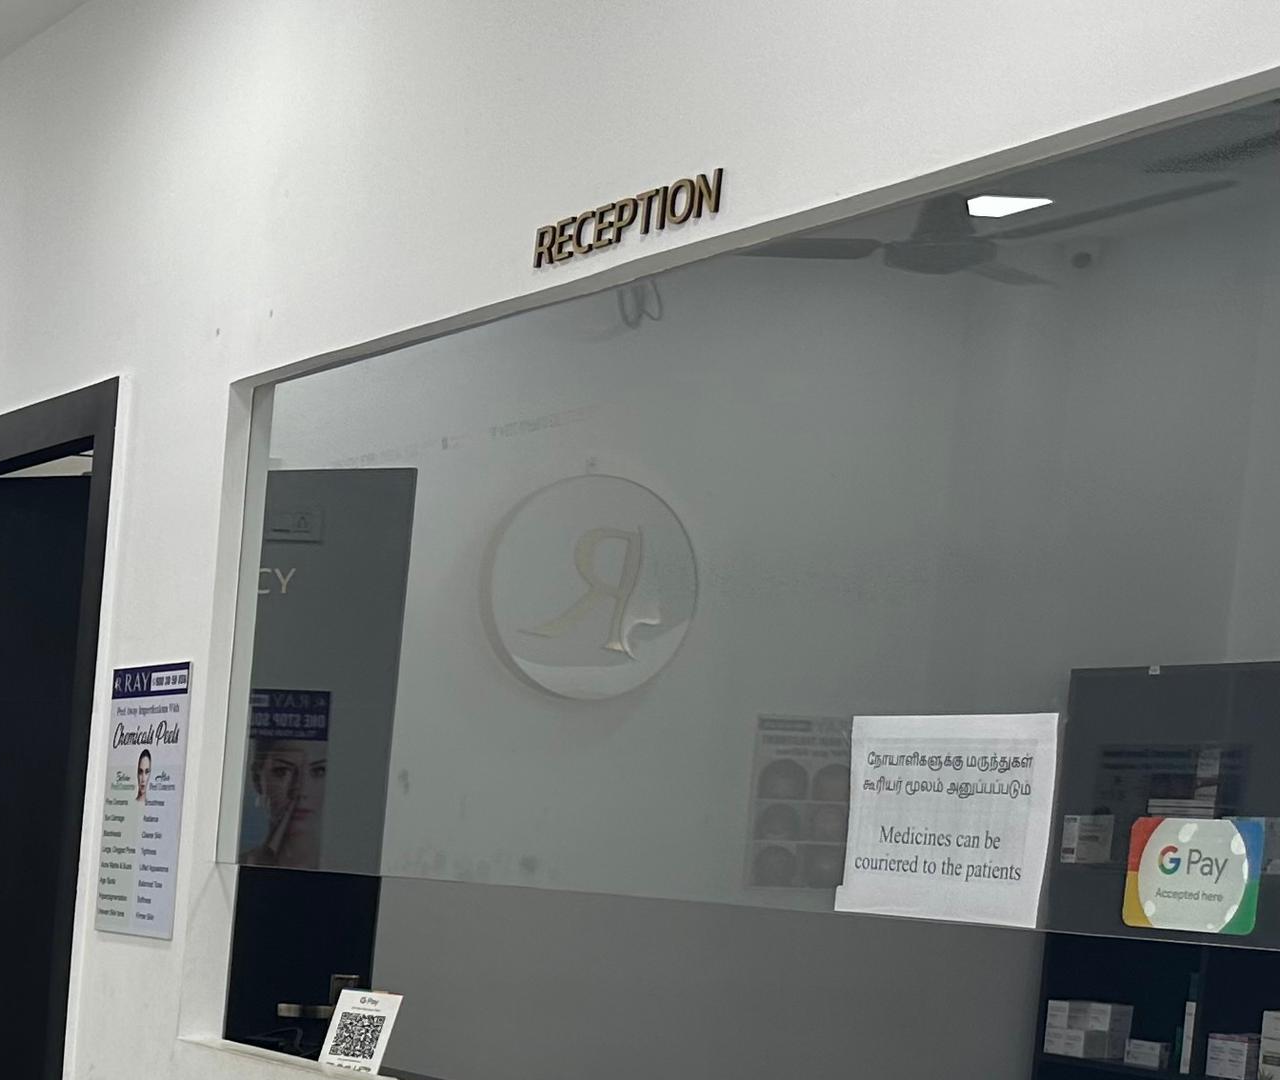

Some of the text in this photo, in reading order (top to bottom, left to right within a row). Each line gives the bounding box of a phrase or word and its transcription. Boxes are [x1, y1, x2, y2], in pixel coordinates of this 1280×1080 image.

[533, 168, 723, 268] RECEPTION
[125, 672, 150, 692] RAY
[155, 720, 179, 746] Peels
[867, 751, 1033, 773] நோயாளிகளுக்கு மருந்துகள்
[863, 776, 1031, 798] கூரியர் மூலம் அனுப்பப்படும்
[879, 825, 1001, 849] Medicines can be
[854, 855, 1021, 881] couriered to the patients
[1158, 845, 1228, 884] G Pay
[1155, 888, 1224, 902] Accepted here
